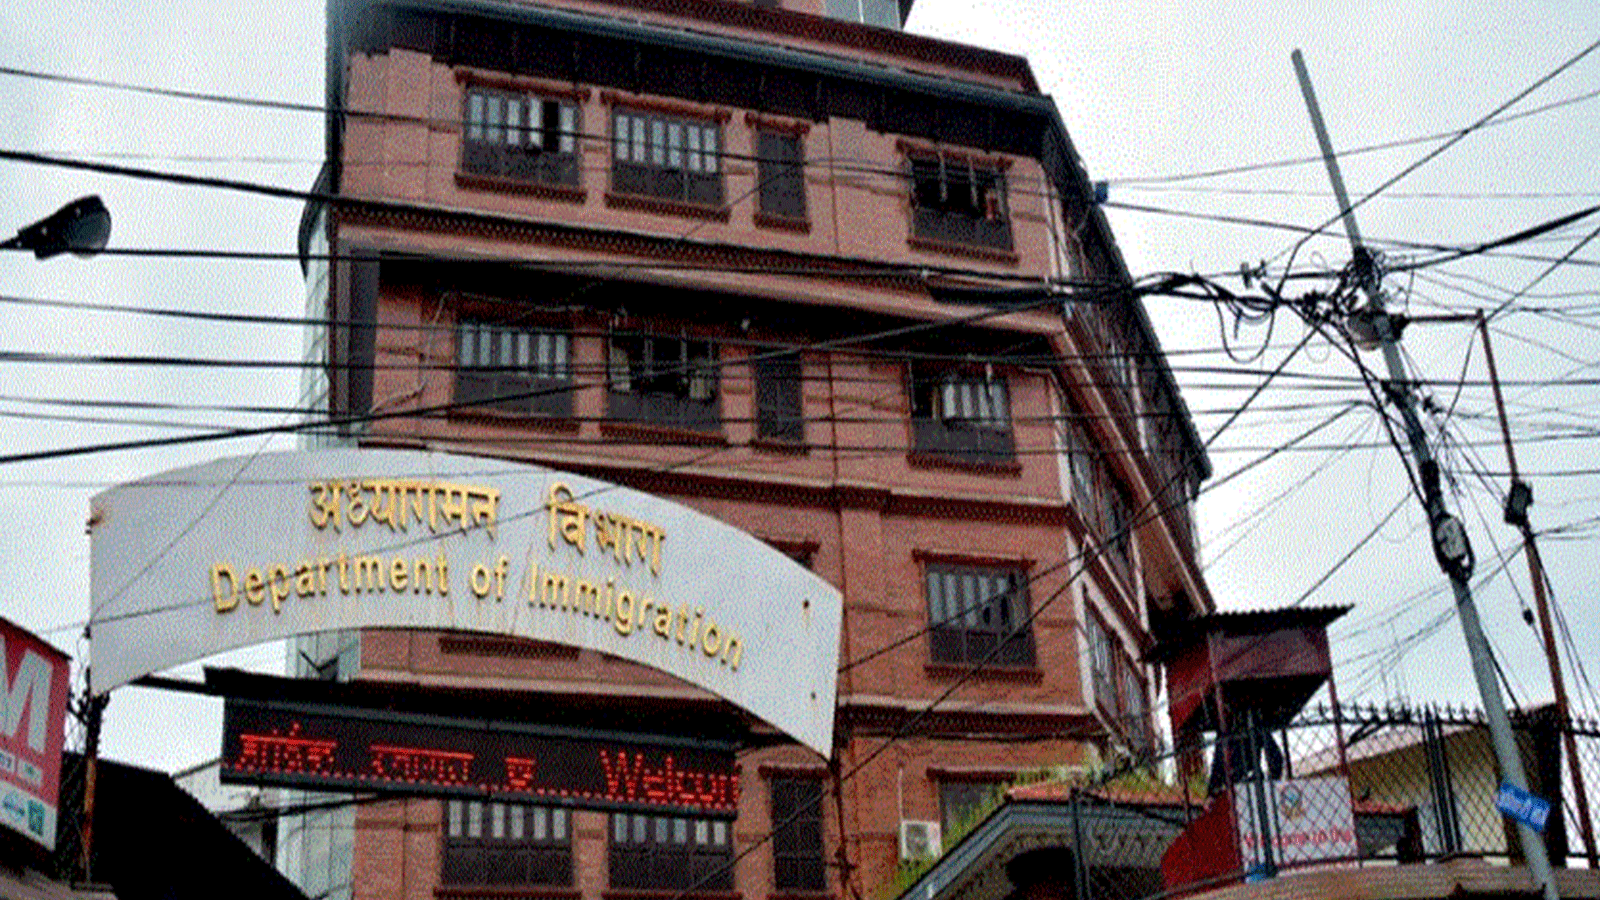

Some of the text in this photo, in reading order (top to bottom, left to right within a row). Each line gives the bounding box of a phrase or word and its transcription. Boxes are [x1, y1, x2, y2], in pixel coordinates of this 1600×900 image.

[546, 481, 667, 578] विभाग
[210, 554, 743, 672] Department of Immigration
